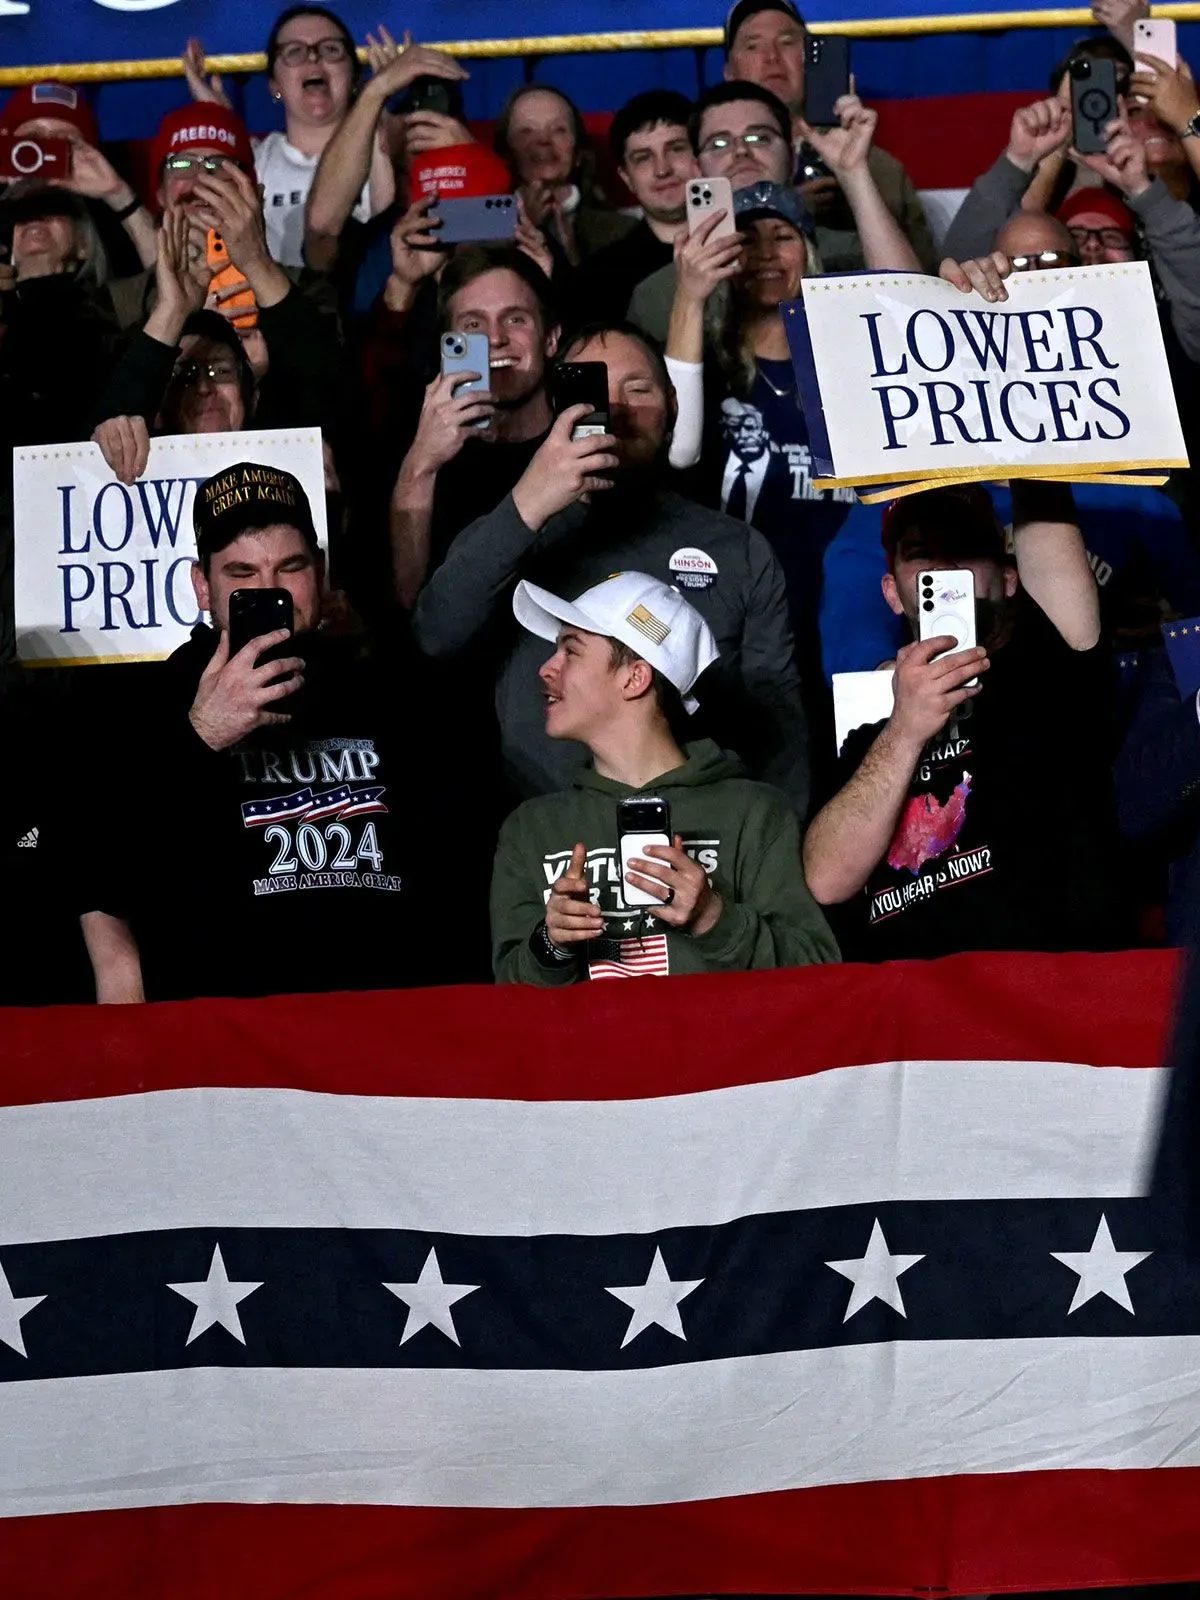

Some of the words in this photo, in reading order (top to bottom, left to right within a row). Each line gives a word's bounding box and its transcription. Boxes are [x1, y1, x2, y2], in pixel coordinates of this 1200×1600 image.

[171, 125, 236, 147] FREEDOM
[859, 306, 1120, 378] LOWER
[871, 378, 1131, 450] PRICES
[205, 472, 238, 503] MAKE
[242, 469, 297, 492] AMERICA
[212, 486, 252, 517] GREAT
[257, 484, 296, 507] AGAIN
[57, 477, 211, 554] LOW
[674, 559, 712, 569] HINSON
[230, 749, 381, 784] TRUMP
[264, 822, 384, 875] 2024
[253, 874, 297, 896] MAKE
[299, 872, 362, 889] AMERICA
[362, 873, 401, 892] GREAT
[874, 888, 902, 915] YOU
[902, 875, 934, 904] HEAR
[947, 849, 991, 880] NOW?
